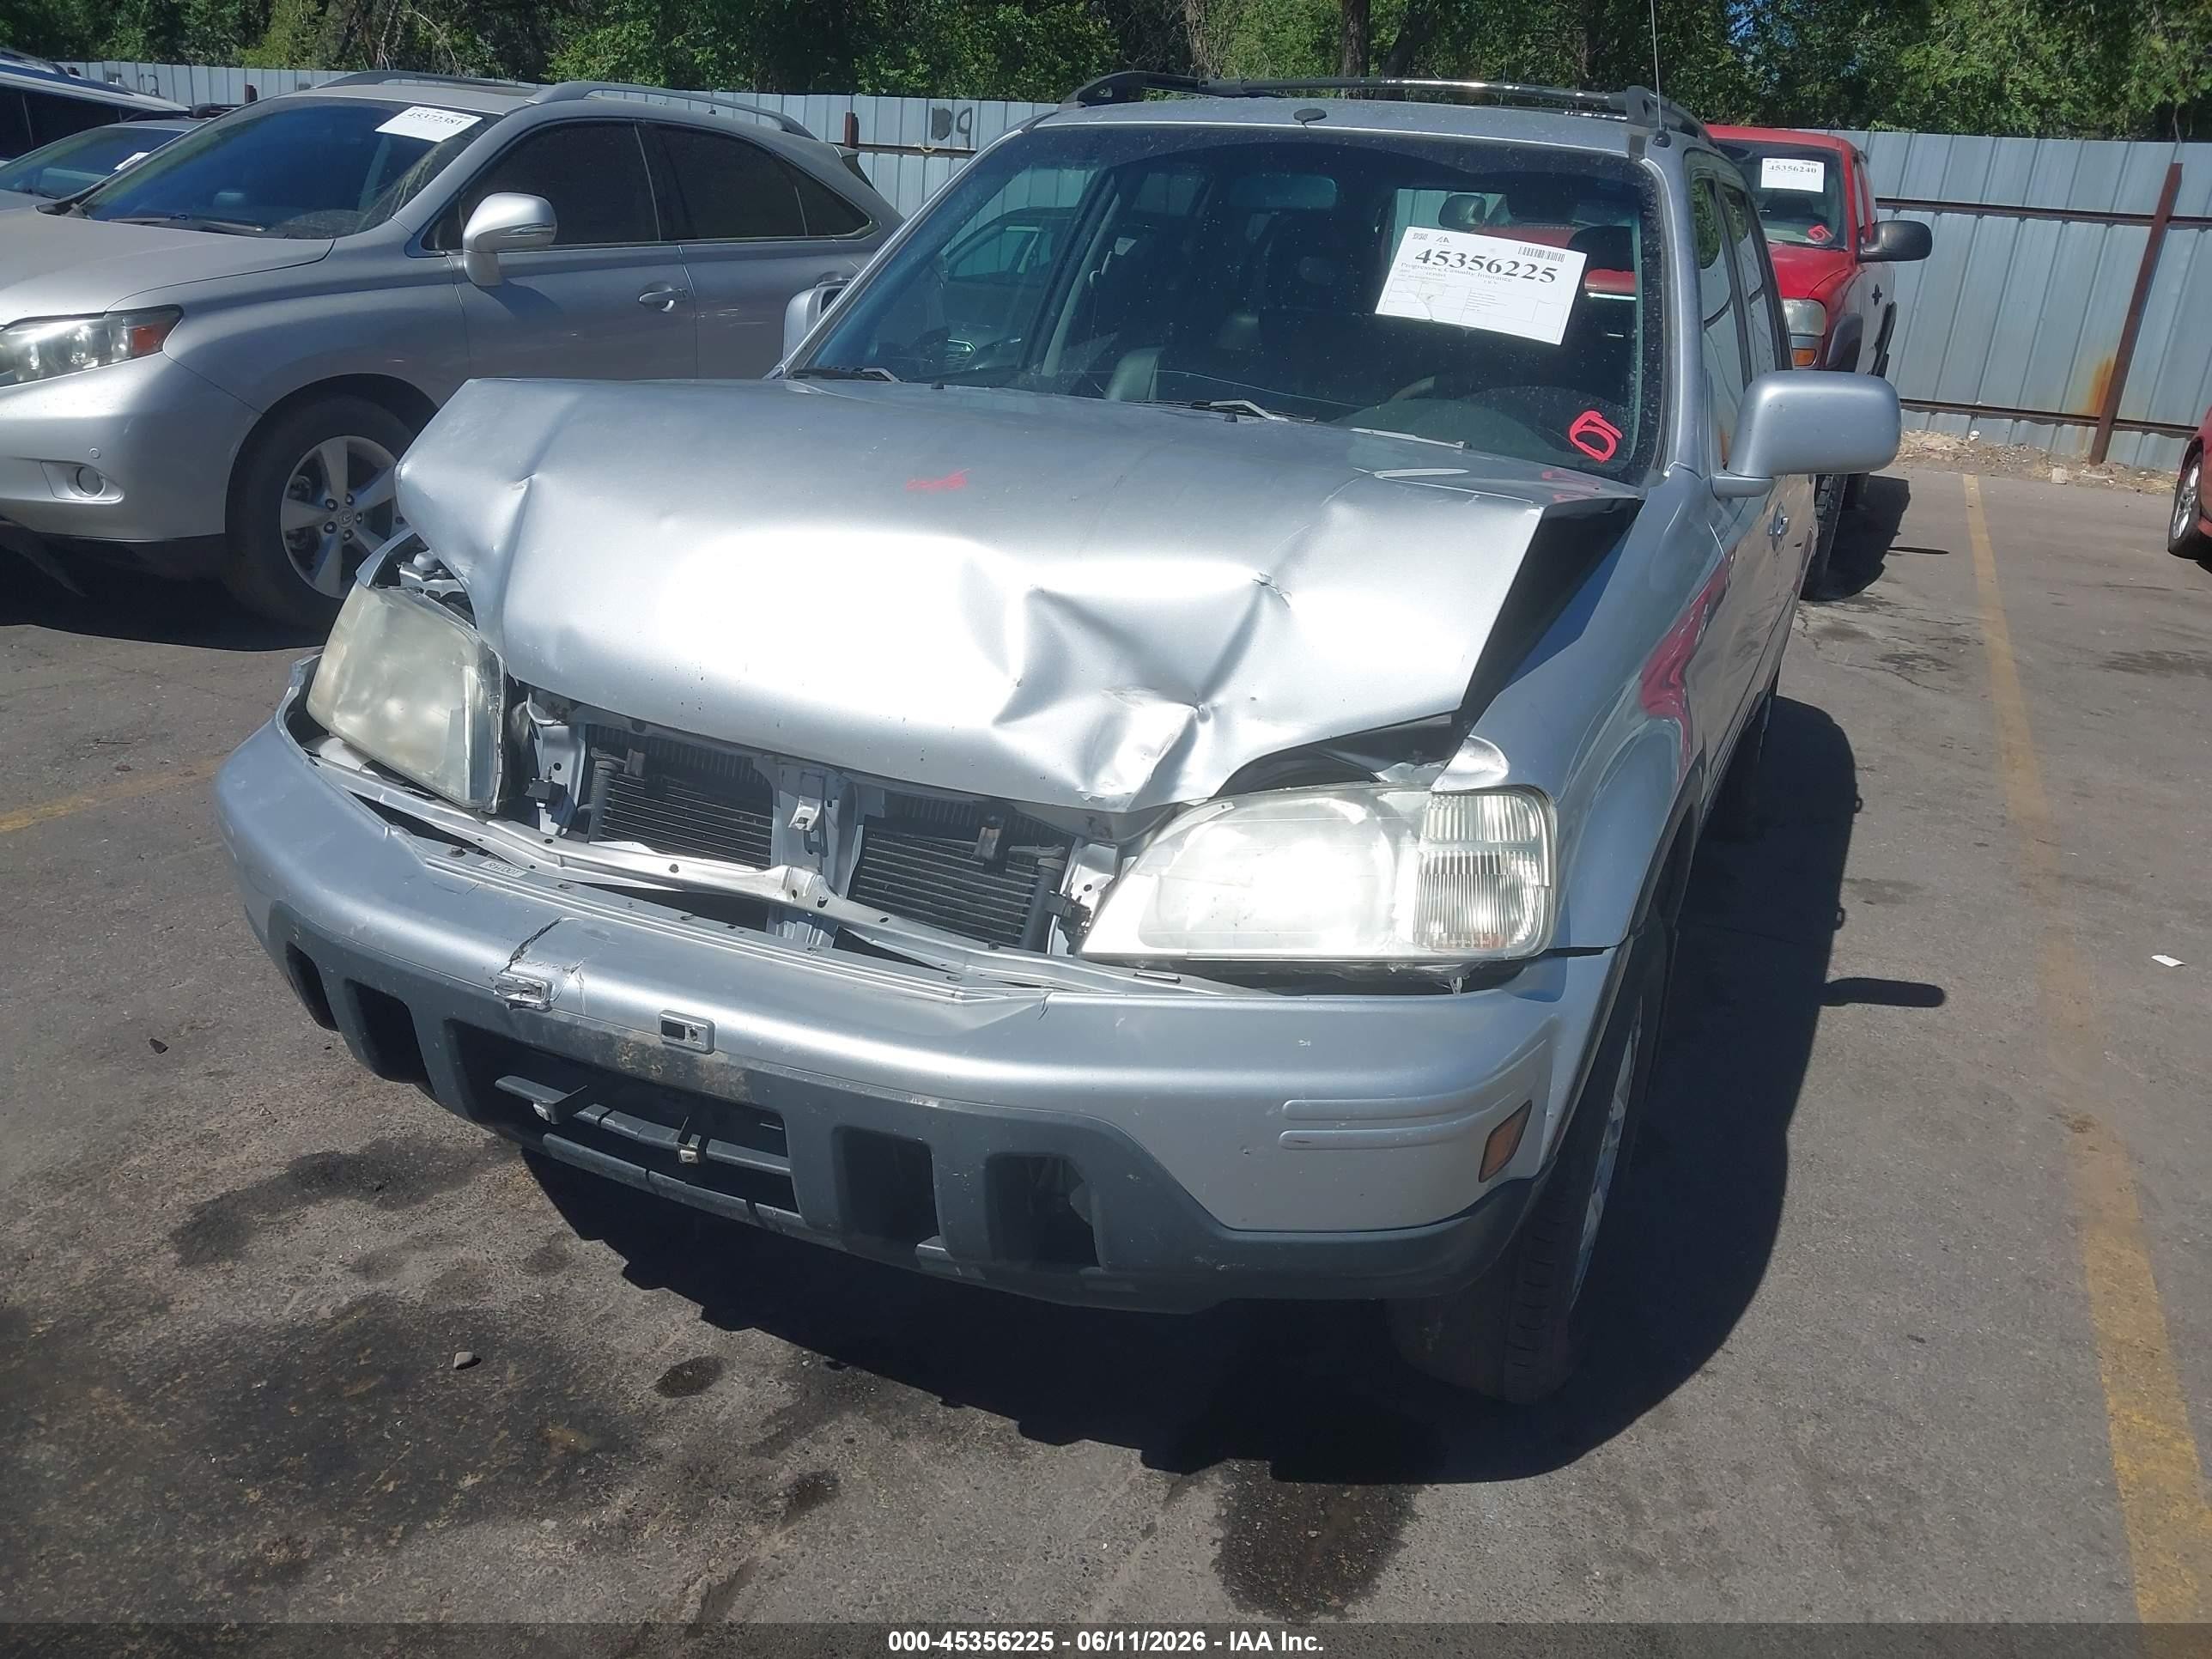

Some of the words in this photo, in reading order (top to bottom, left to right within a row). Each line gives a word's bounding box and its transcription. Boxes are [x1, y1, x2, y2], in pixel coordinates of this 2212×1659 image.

[1769, 165, 1817, 173] 45356240
[1401, 262, 1442, 272] Progressive
[1443, 268, 1475, 276] Casualty
[1477, 273, 1513, 283] Insurance
[1414, 249, 1559, 283] 45356225
